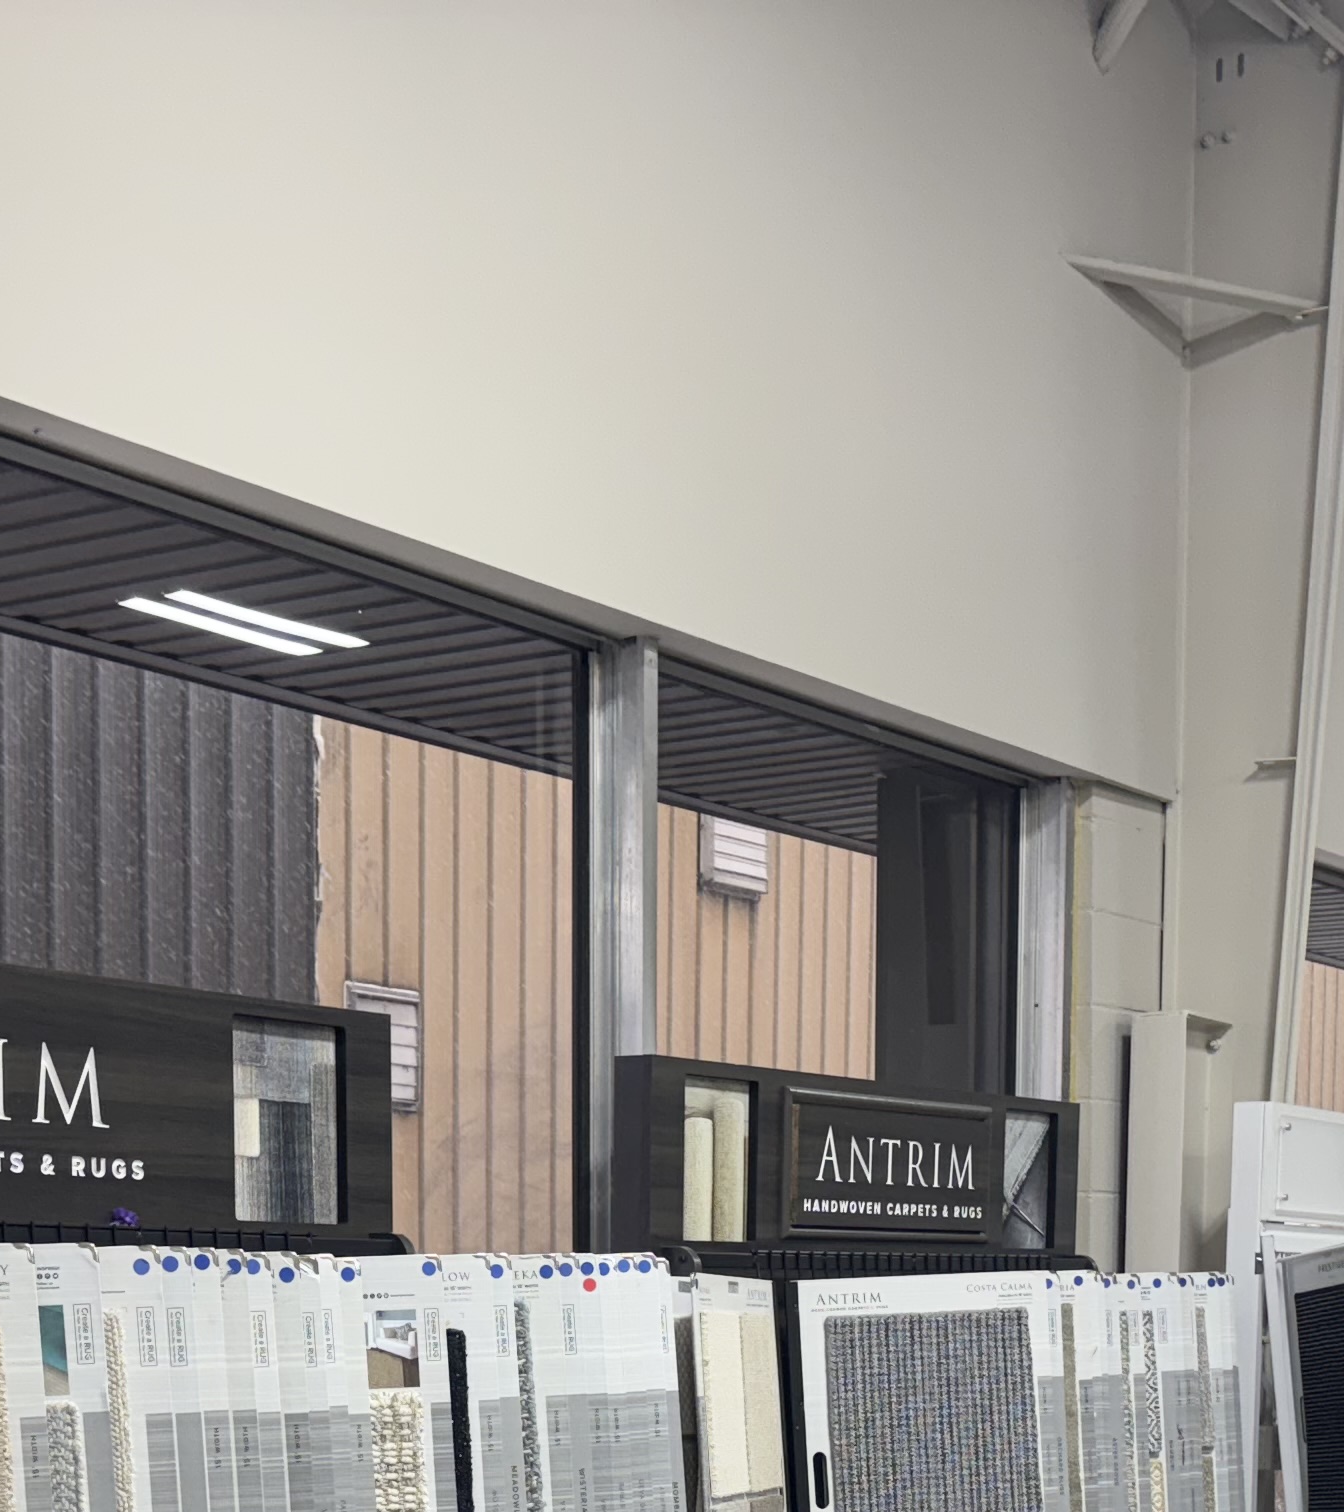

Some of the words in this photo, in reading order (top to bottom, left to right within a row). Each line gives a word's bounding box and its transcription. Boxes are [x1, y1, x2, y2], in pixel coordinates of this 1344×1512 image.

[40, 1153, 56, 1175] &
[71, 1156, 146, 1181] RUGS
[815, 1125, 975, 1191] ANTRIM
[803, 1197, 881, 1215] HANDWOVEN
[887, 1202, 938, 1218] CARPETS
[941, 1205, 949, 1218] &
[954, 1206, 983, 1219] RUGS
[966, 1284, 997, 1293] COSTA
[1000, 1282, 1033, 1292] CALMA
[816, 1292, 882, 1306] ANTRIM
